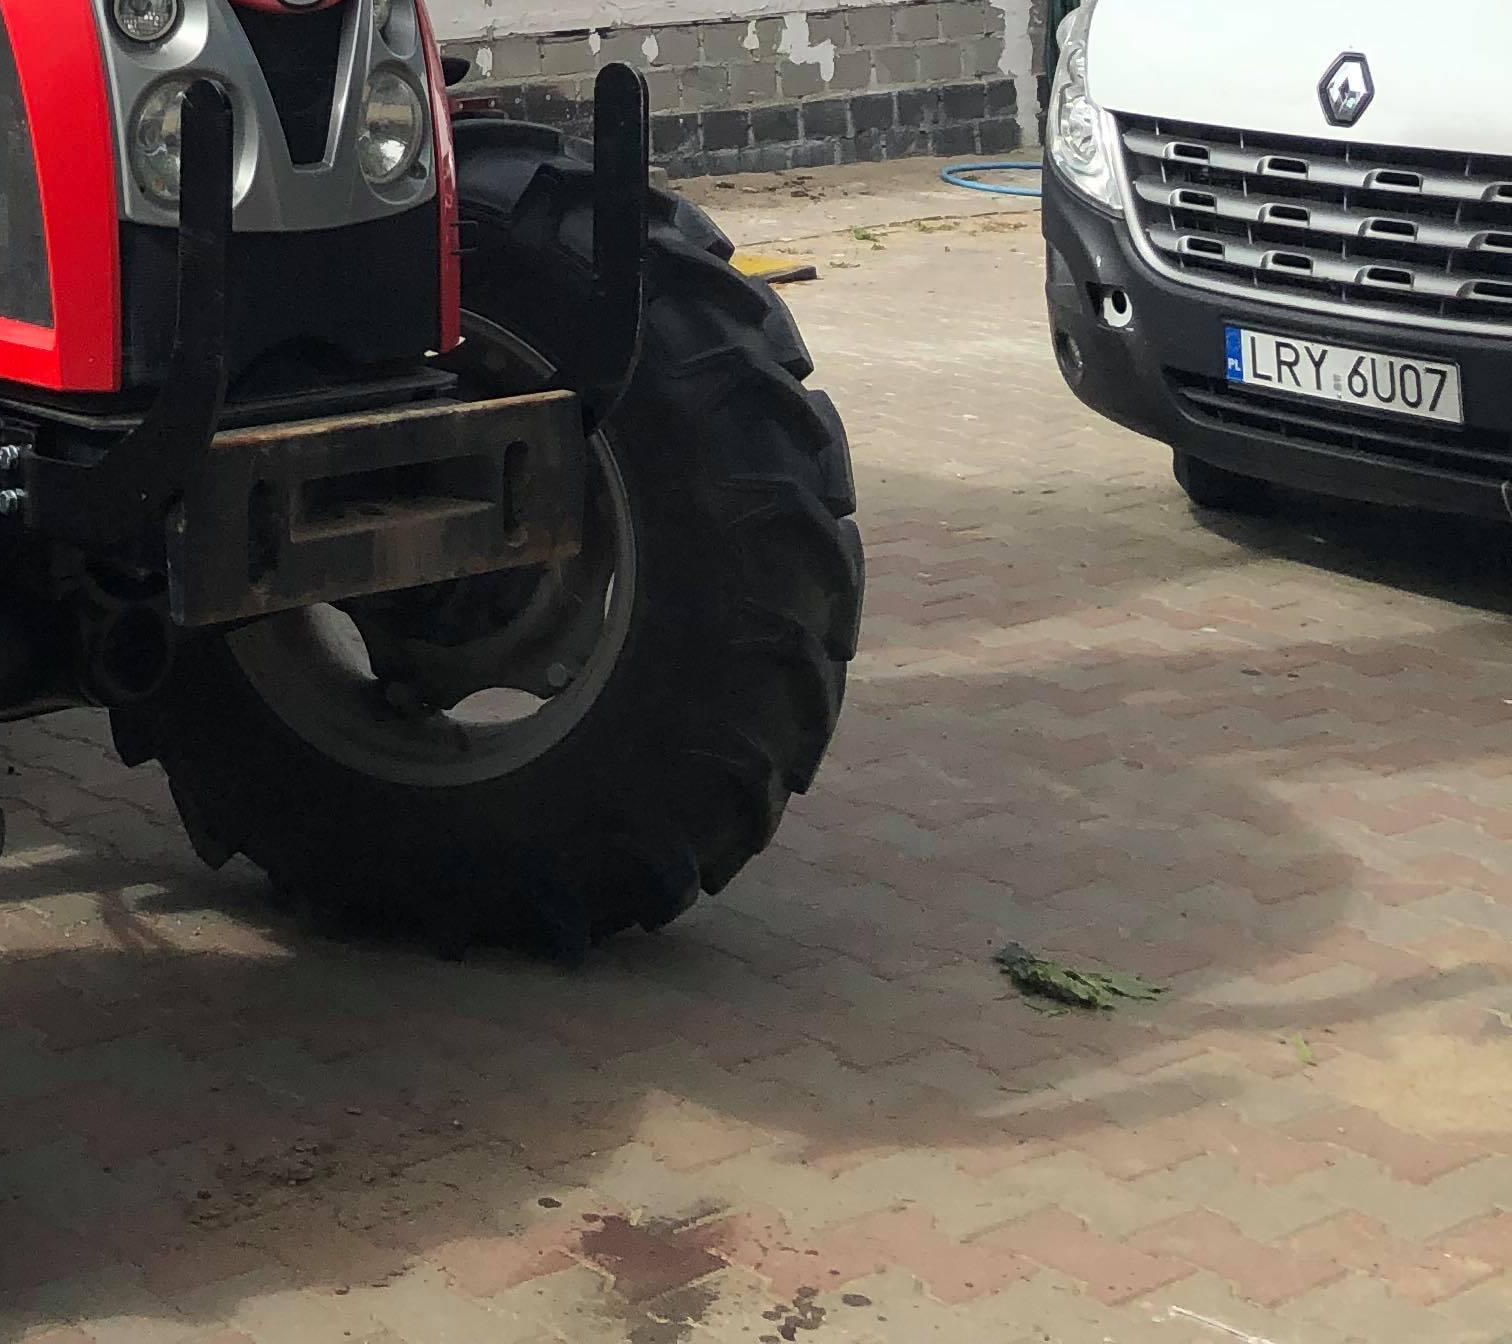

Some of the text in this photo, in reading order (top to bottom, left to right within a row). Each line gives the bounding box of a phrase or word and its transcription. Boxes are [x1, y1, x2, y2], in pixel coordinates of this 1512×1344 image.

[1228, 357, 1241, 372] PL
[1249, 336, 1447, 411] LRY 6U07
